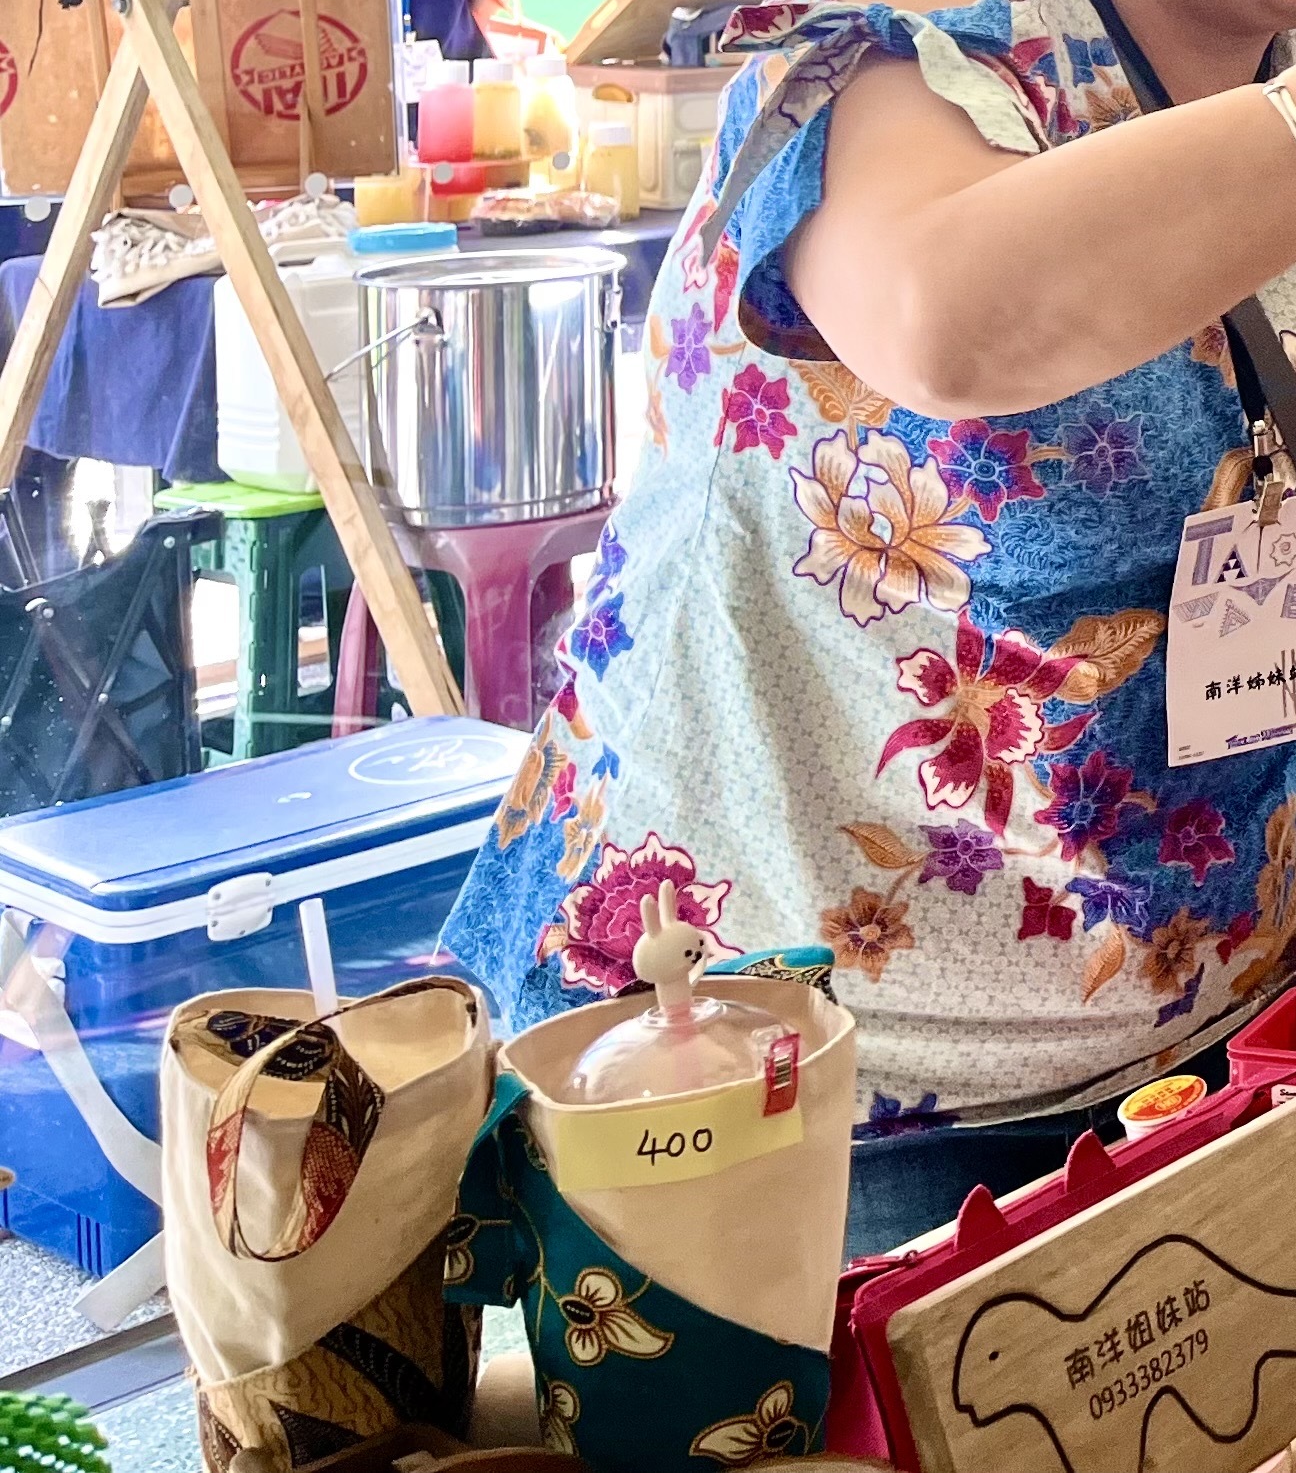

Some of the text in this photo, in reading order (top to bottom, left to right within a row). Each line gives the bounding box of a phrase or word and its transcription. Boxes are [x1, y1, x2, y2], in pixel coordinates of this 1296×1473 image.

[637, 1128, 712, 1166] 400
[1064, 1280, 1210, 1390] 南洋姐妹站
[1089, 1328, 1209, 1420] 0933382379
